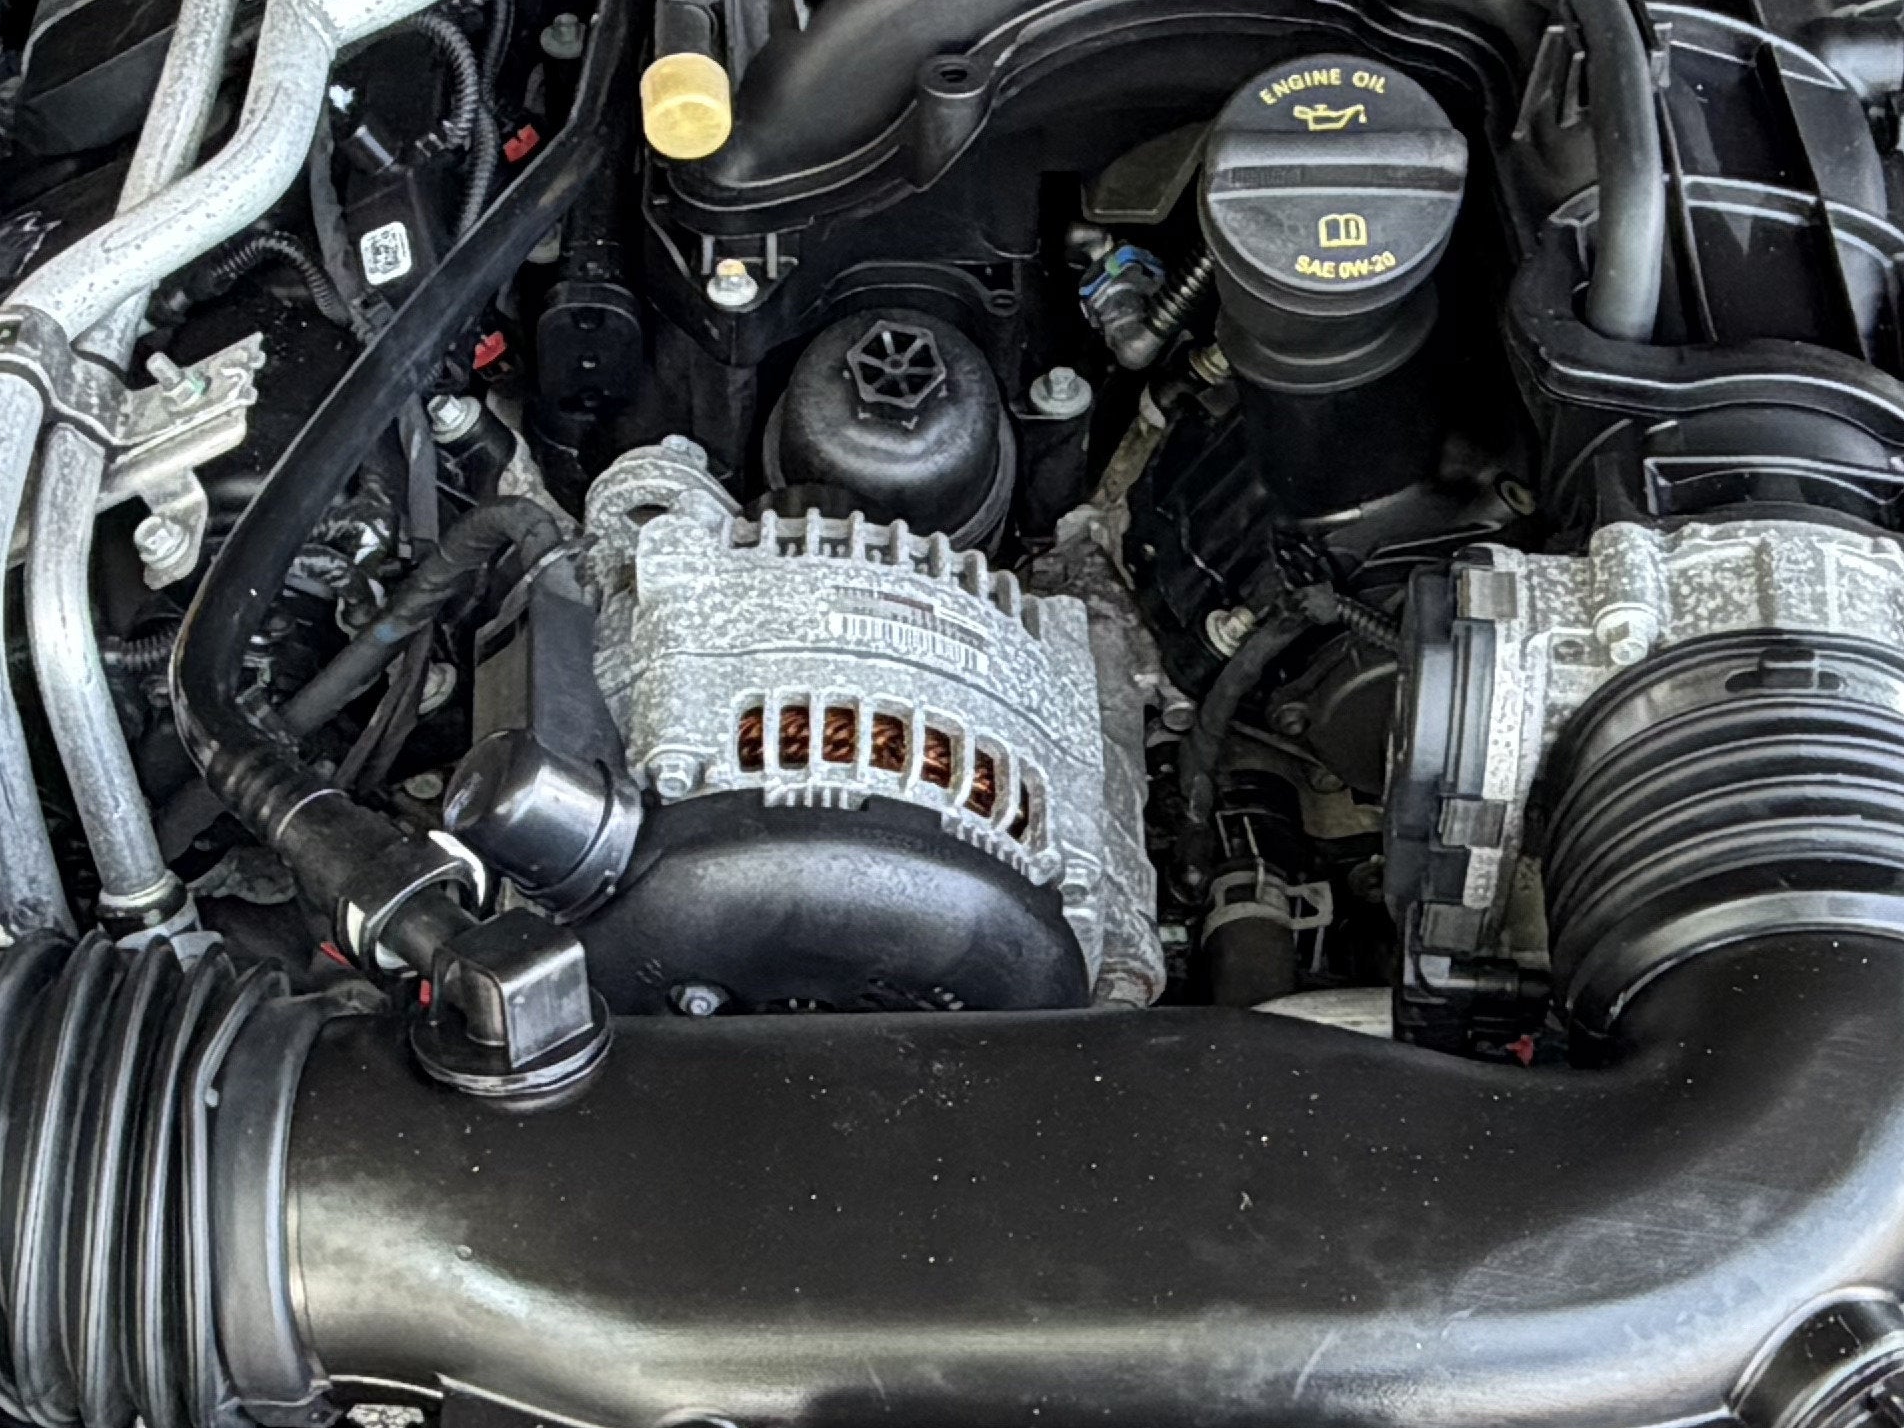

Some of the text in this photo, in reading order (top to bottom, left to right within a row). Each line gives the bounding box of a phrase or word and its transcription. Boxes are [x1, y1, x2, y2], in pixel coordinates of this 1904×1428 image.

[1259, 68, 1386, 105] ENGINE OIL
[1295, 250, 1396, 279] SAE 0W-20
